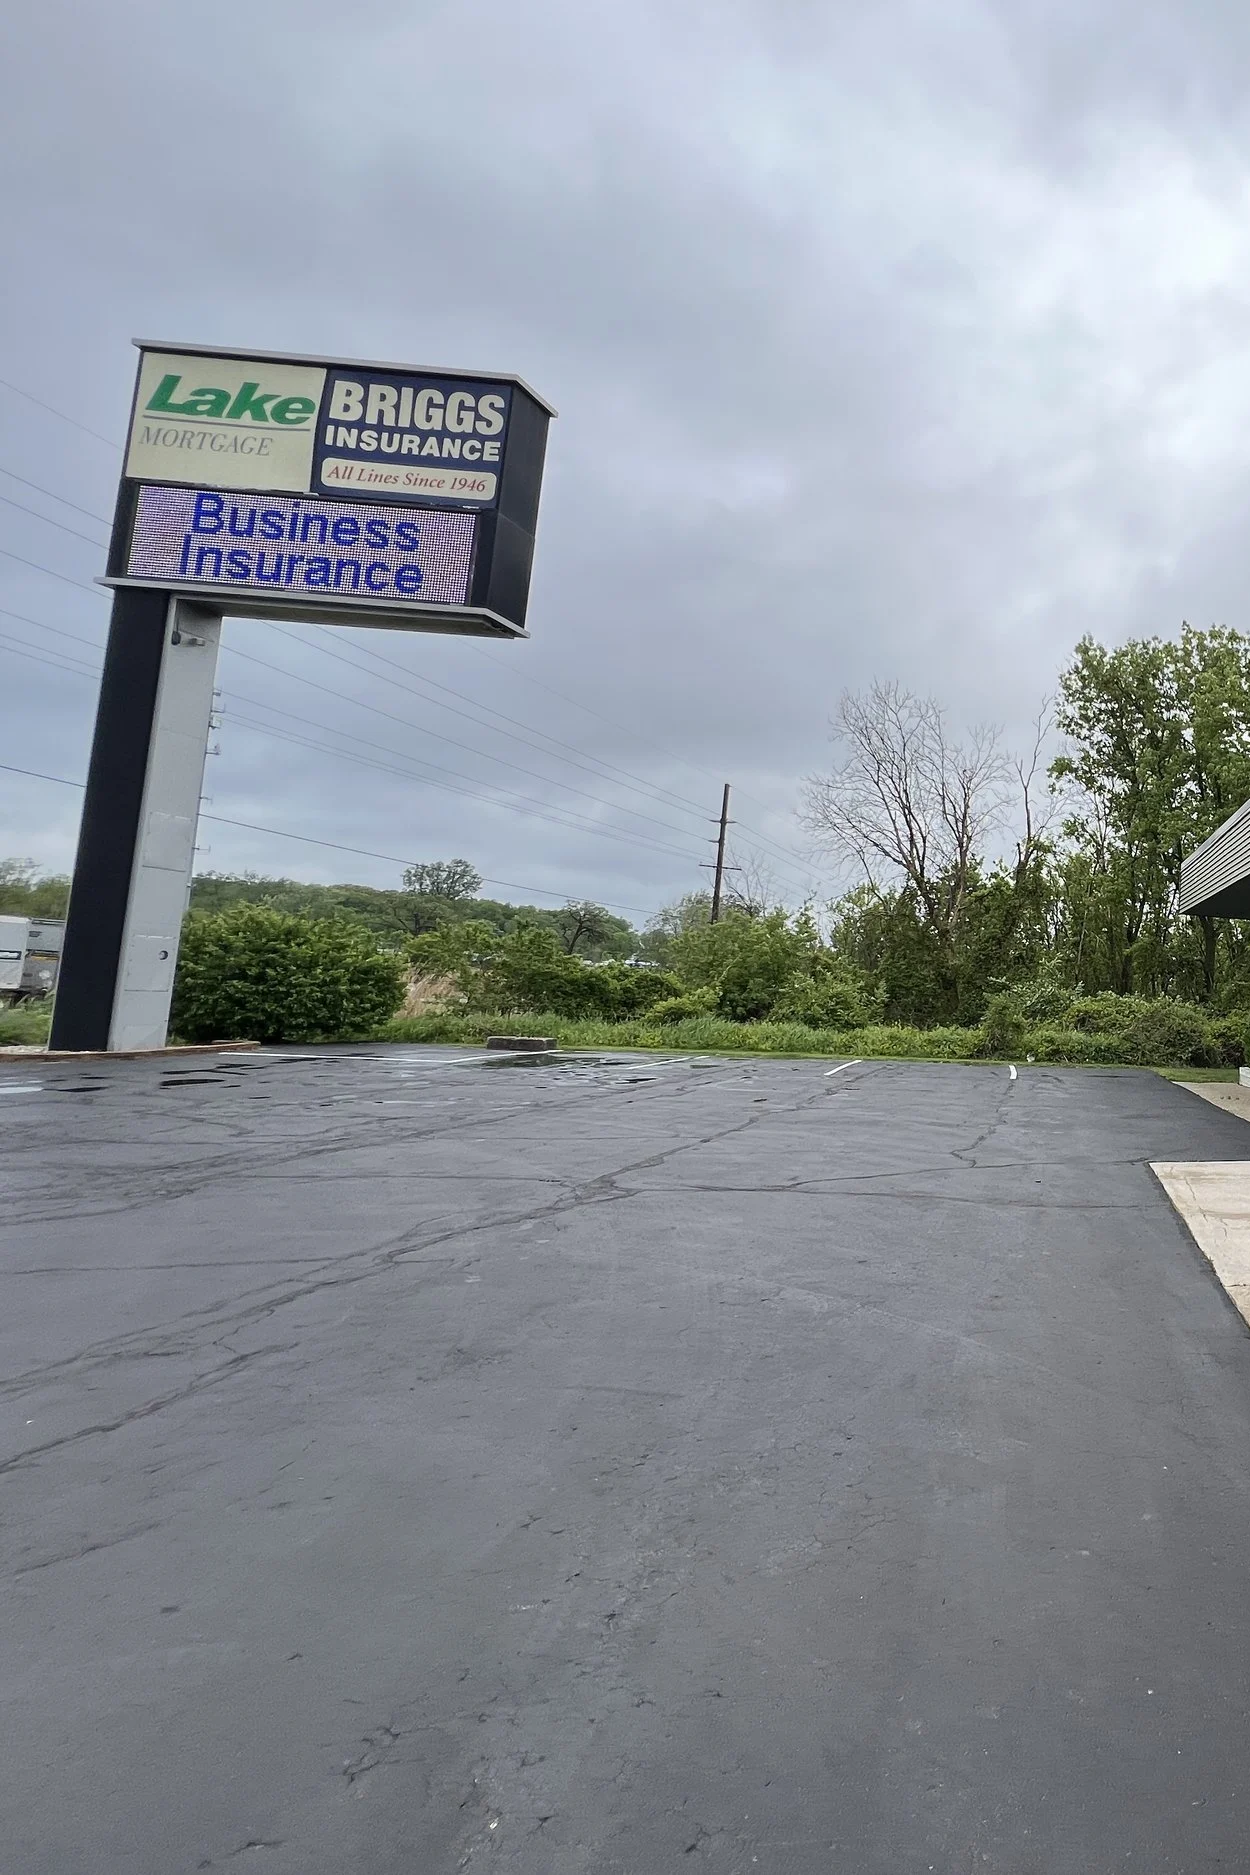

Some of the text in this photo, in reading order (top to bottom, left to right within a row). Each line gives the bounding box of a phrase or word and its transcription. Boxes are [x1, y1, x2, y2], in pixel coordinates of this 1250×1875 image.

[144, 374, 315, 425] Lake
[329, 380, 505, 435] BRIGGS
[138, 425, 273, 456] MORTGAGE
[325, 425, 501, 462] INSURANCE
[327, 465, 486, 492] All Lines Since 1946
[192, 492, 421, 552] Business
[180, 534, 424, 595] Insurance
